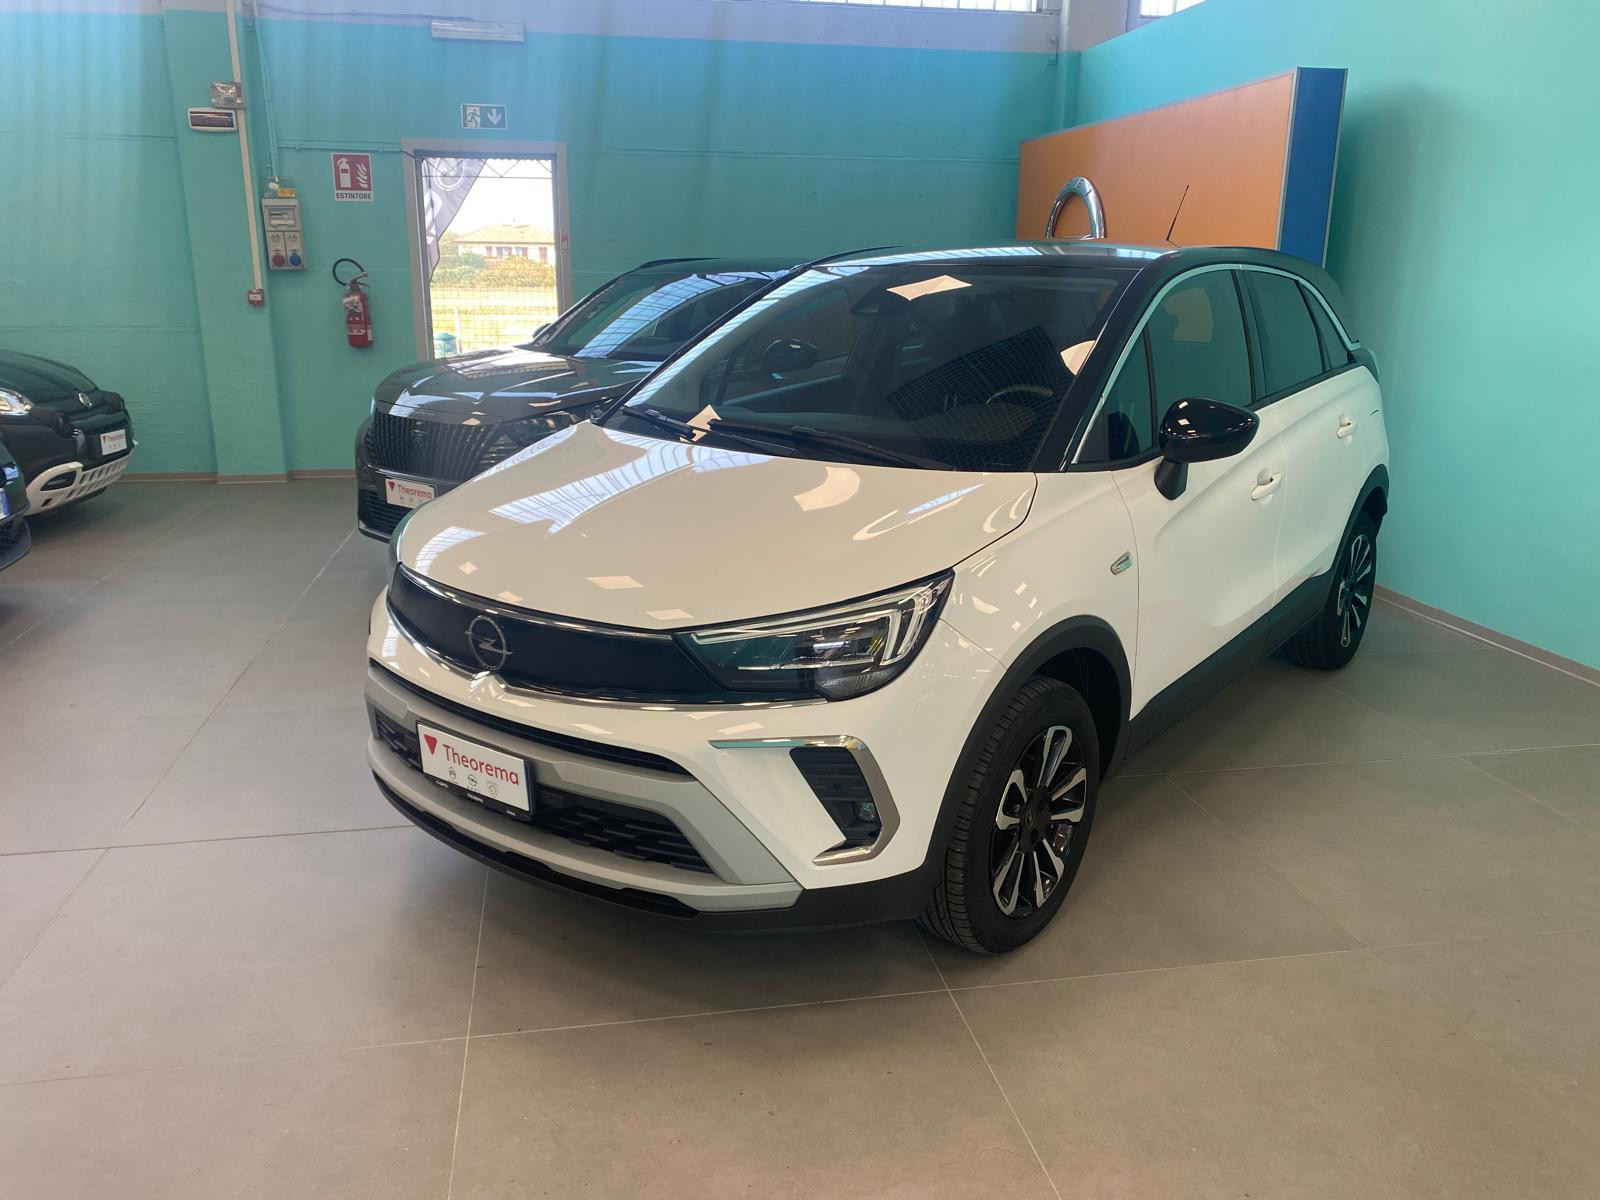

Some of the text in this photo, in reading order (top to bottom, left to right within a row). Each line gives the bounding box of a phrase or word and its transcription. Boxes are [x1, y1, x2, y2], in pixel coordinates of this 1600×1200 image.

[336, 192, 373, 200] ESTINTORE
[397, 484, 432, 499] Theorema
[442, 743, 520, 786] Theorema
